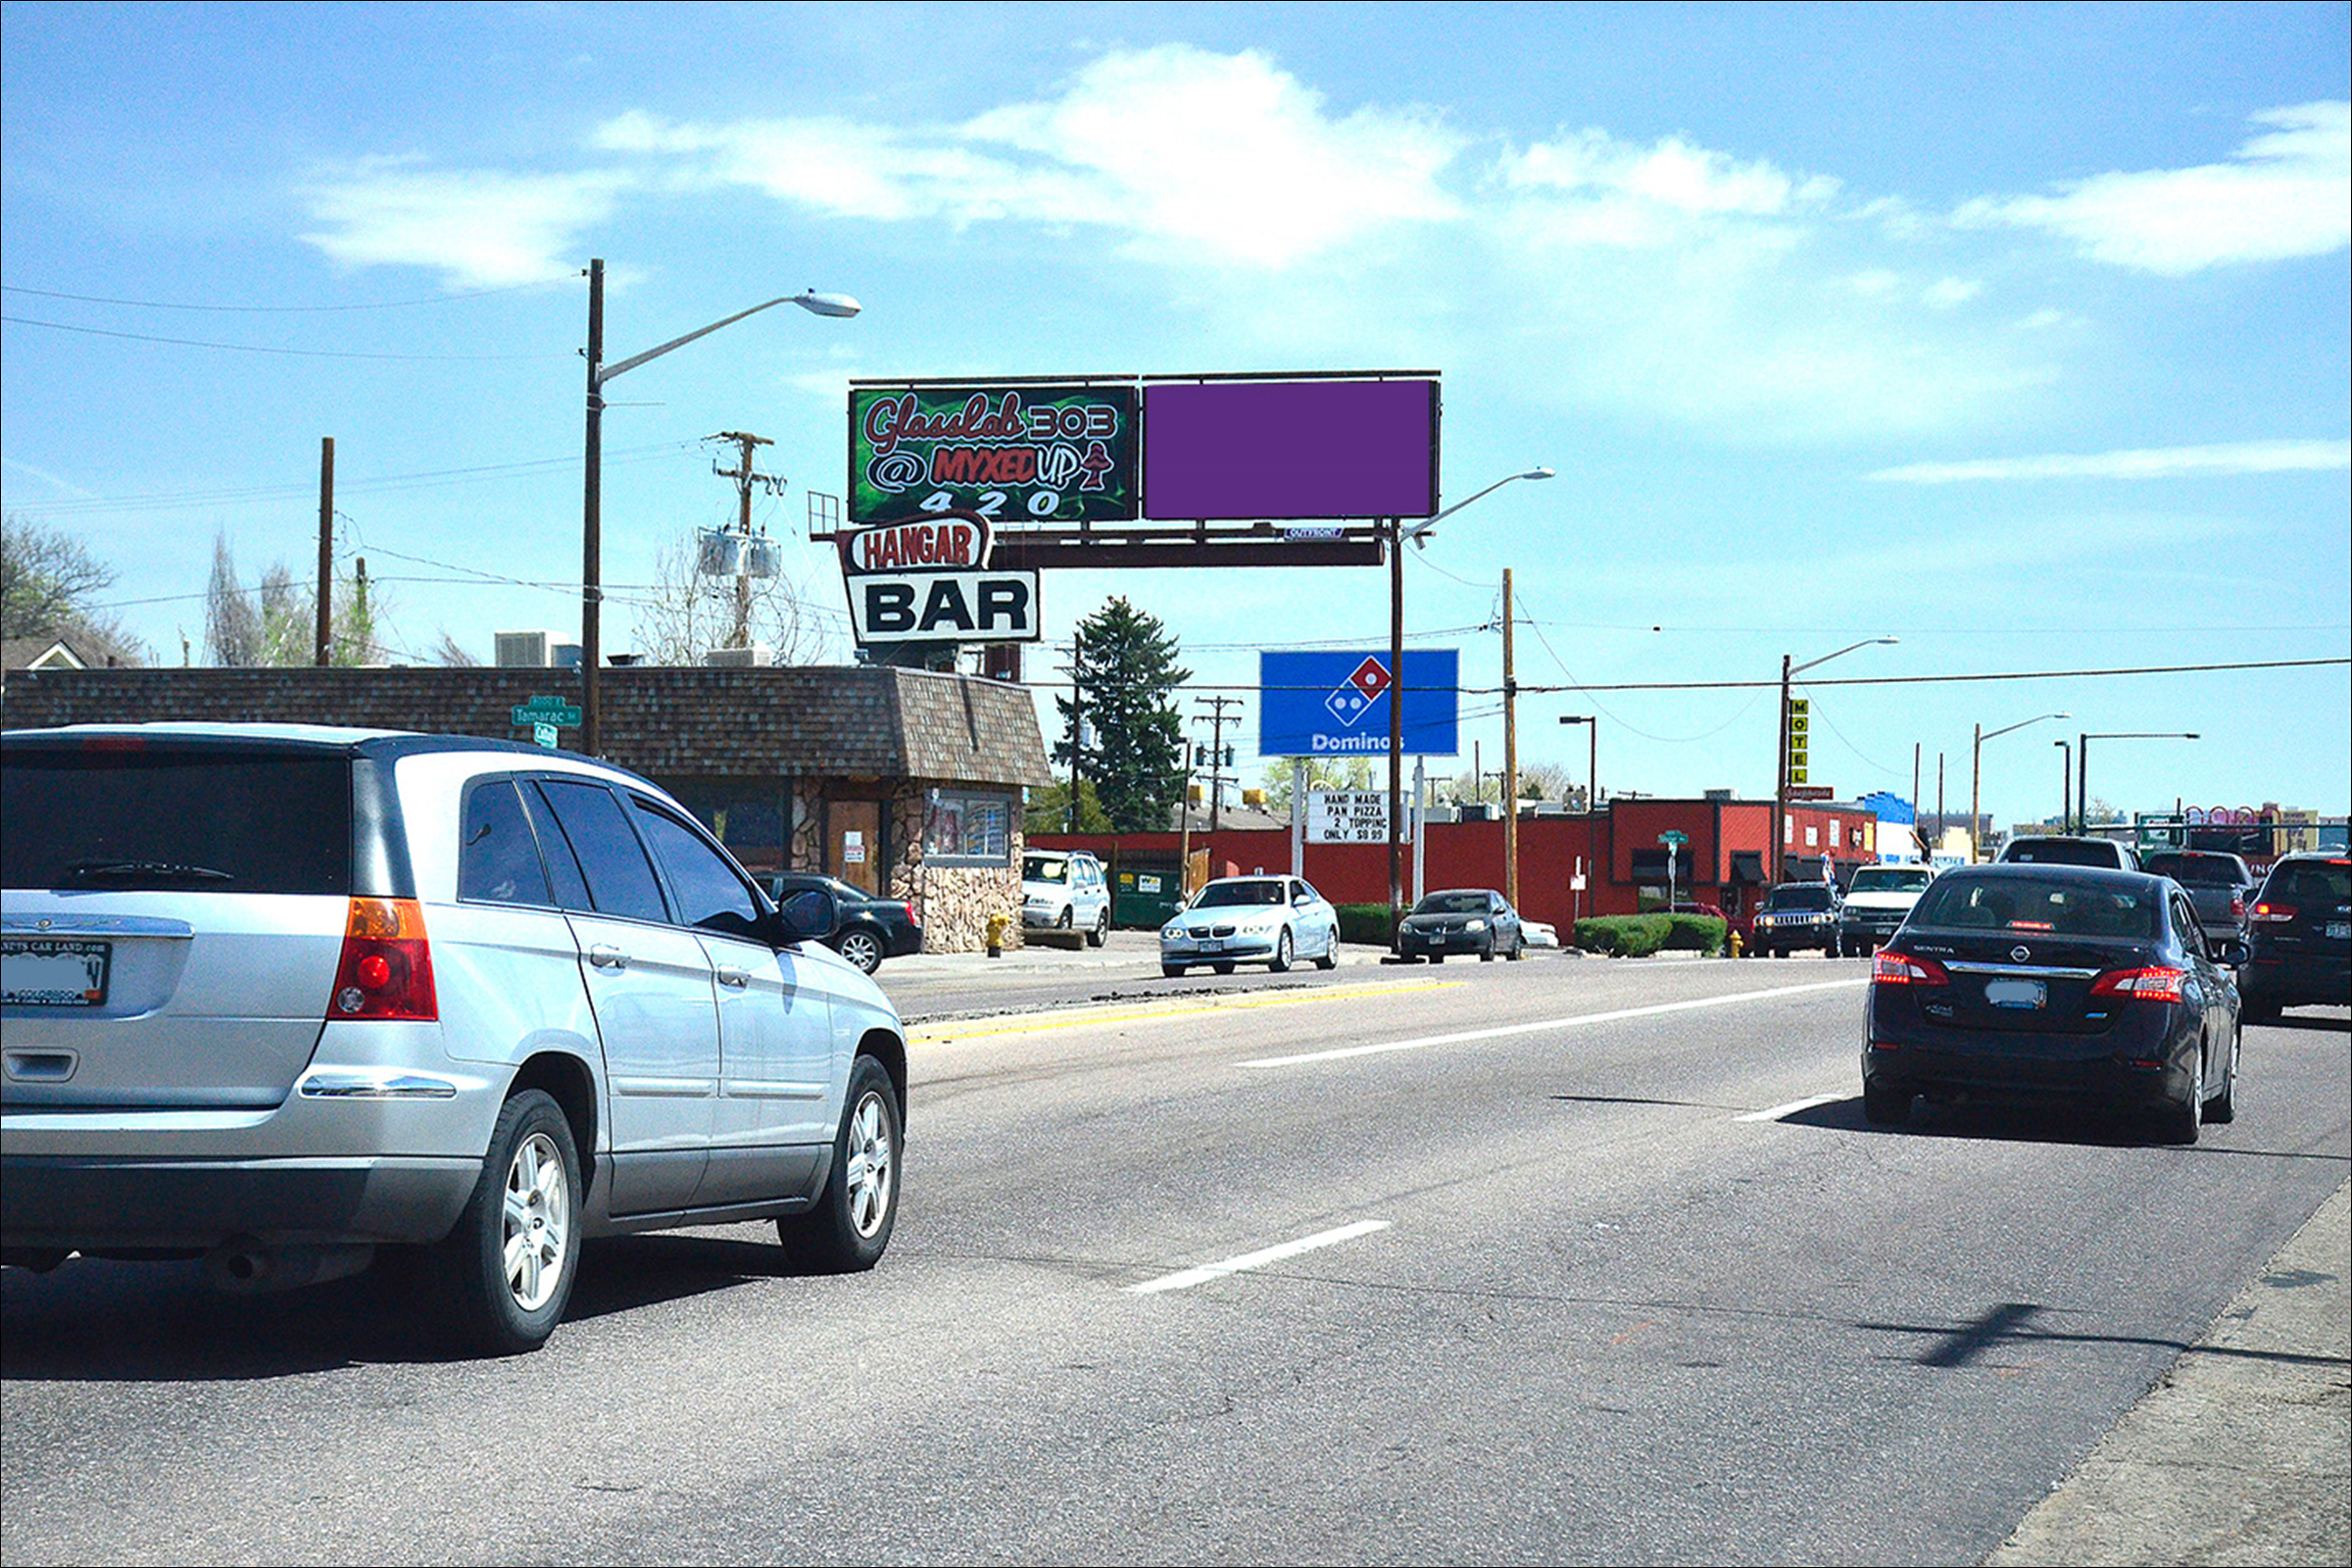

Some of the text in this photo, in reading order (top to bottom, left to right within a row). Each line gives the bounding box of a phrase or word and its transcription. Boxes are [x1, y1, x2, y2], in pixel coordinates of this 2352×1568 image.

[1028, 406, 1118, 438] 303
[863, 525, 972, 568] HANGAR
[865, 579, 1029, 632] BAR
[515, 709, 564, 722] Tamarac
[1794, 703, 1804, 782] MOTEL
[1324, 795, 1381, 804] HAND MADE
[1327, 807, 1382, 815] PAN PIZZA
[1334, 817, 1341, 827] 2
[1324, 829, 1349, 840] ONLY
[30, 942, 52, 952] CAR
[56, 942, 82, 952] LAND
[1914, 945, 1955, 955] SENTRA
[18, 989, 74, 1000] COLORADO
